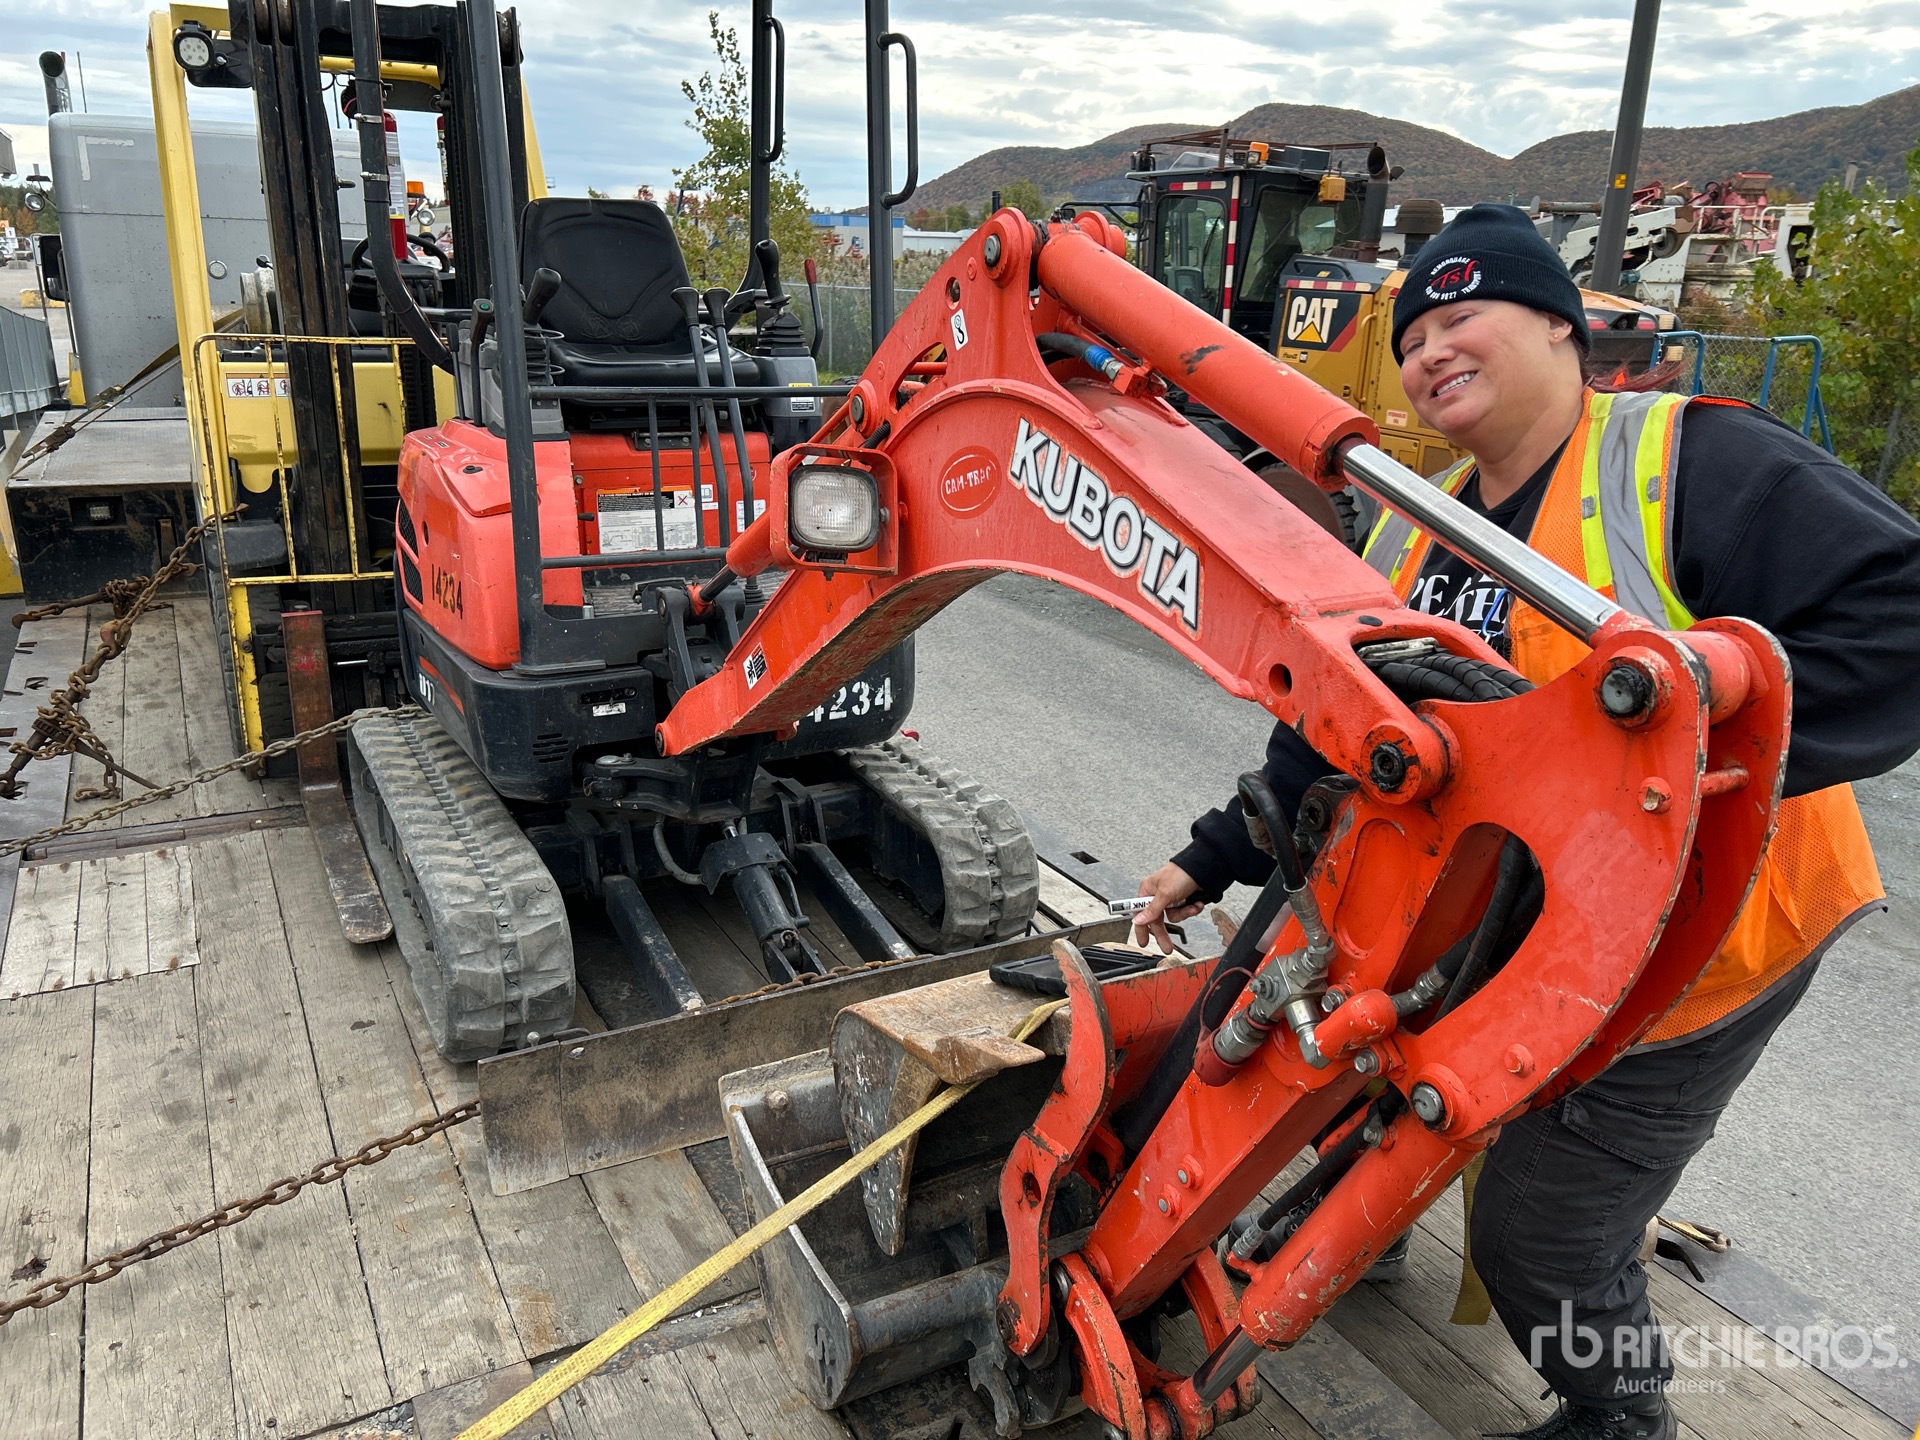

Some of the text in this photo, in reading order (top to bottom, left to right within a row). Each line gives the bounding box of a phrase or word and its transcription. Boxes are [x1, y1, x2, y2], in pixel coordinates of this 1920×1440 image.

[1287, 296, 1339, 344] CAT
[1010, 416, 1199, 631] KUBOTA
[432, 563, 463, 620] 14234
[796, 677, 893, 723] 4234
